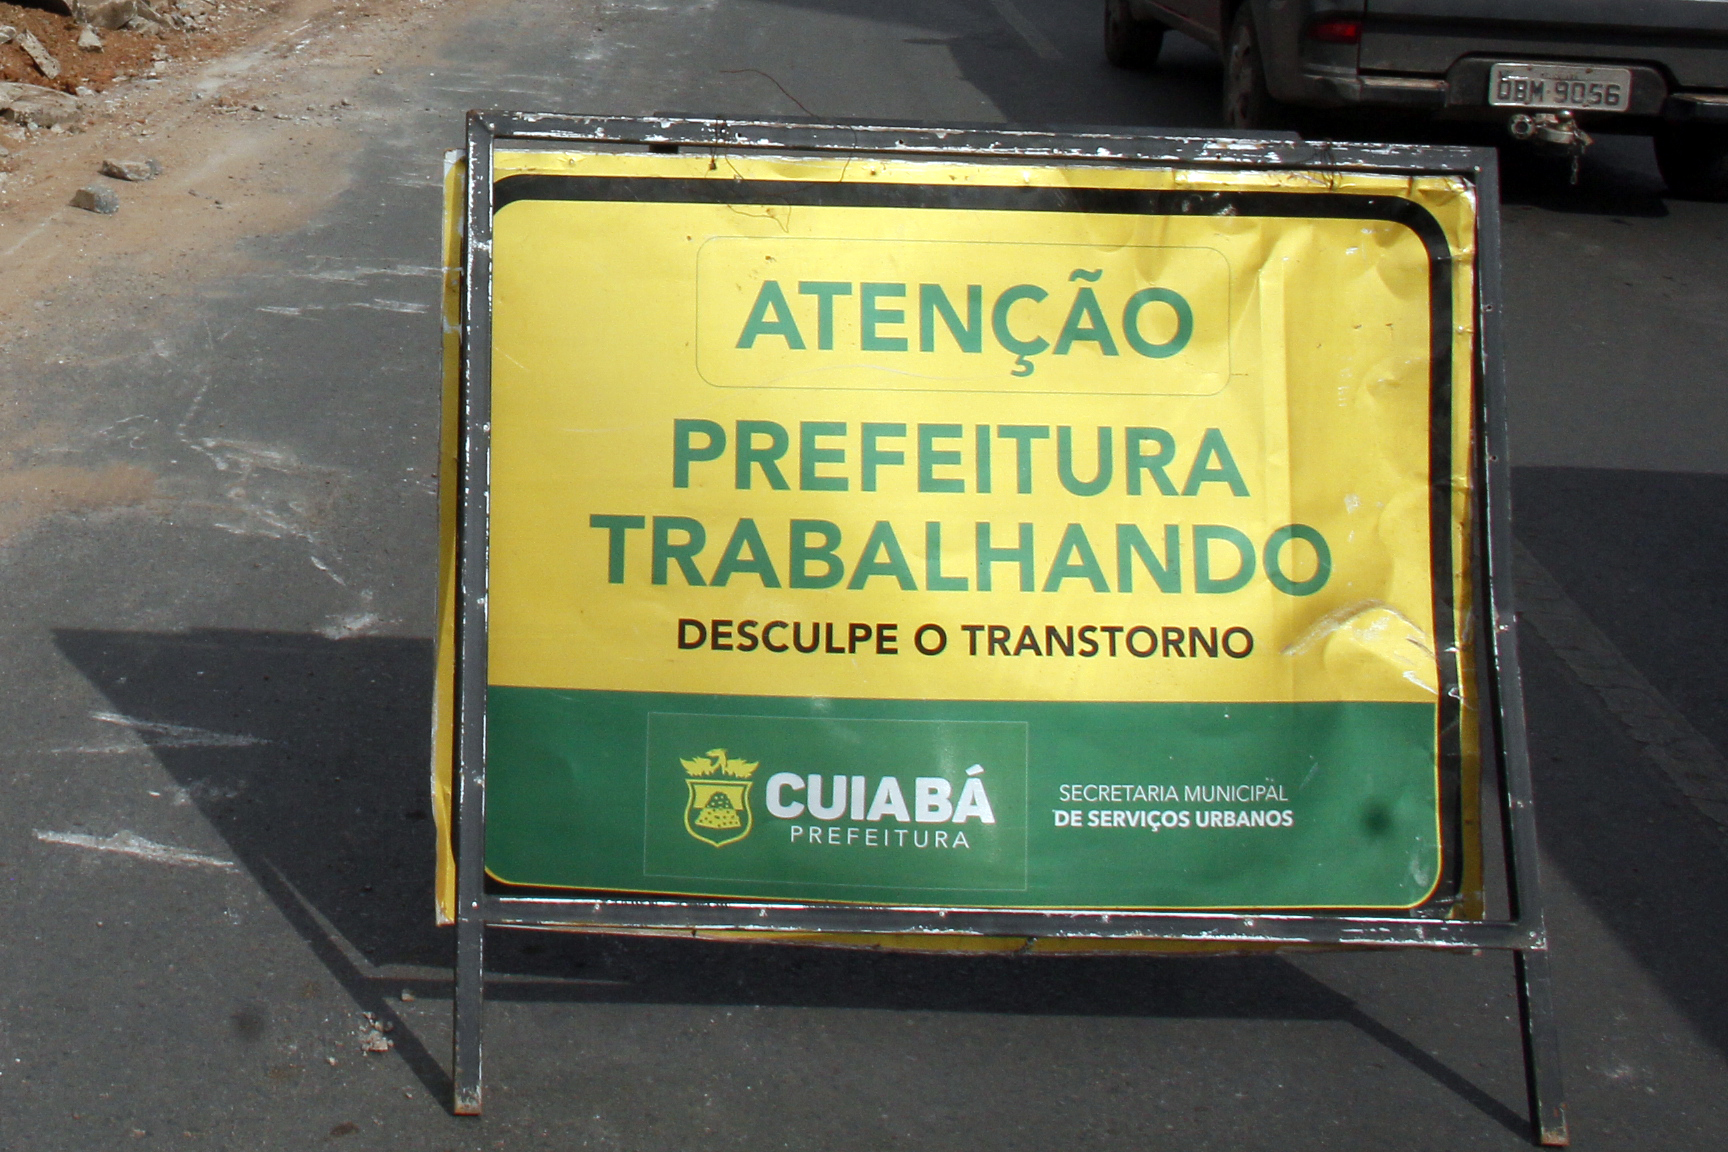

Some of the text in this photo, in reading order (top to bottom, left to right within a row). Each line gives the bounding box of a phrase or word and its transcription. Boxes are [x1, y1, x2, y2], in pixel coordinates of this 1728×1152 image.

[735, 269, 1194, 377] ATENÇÃO
[672, 418, 1249, 498] PREFEITURA
[590, 514, 1332, 598] TRABALHANDO
[677, 618, 1255, 659] DESCULPE O TRANSTORNO
[764, 764, 995, 824] CUIABÁ
[1059, 782, 1288, 803] SECRETARIA MUNICIPAL
[789, 826, 970, 849] PREFEITURA
[1053, 810, 1294, 833] DE SERVIÇOS URBANOS
